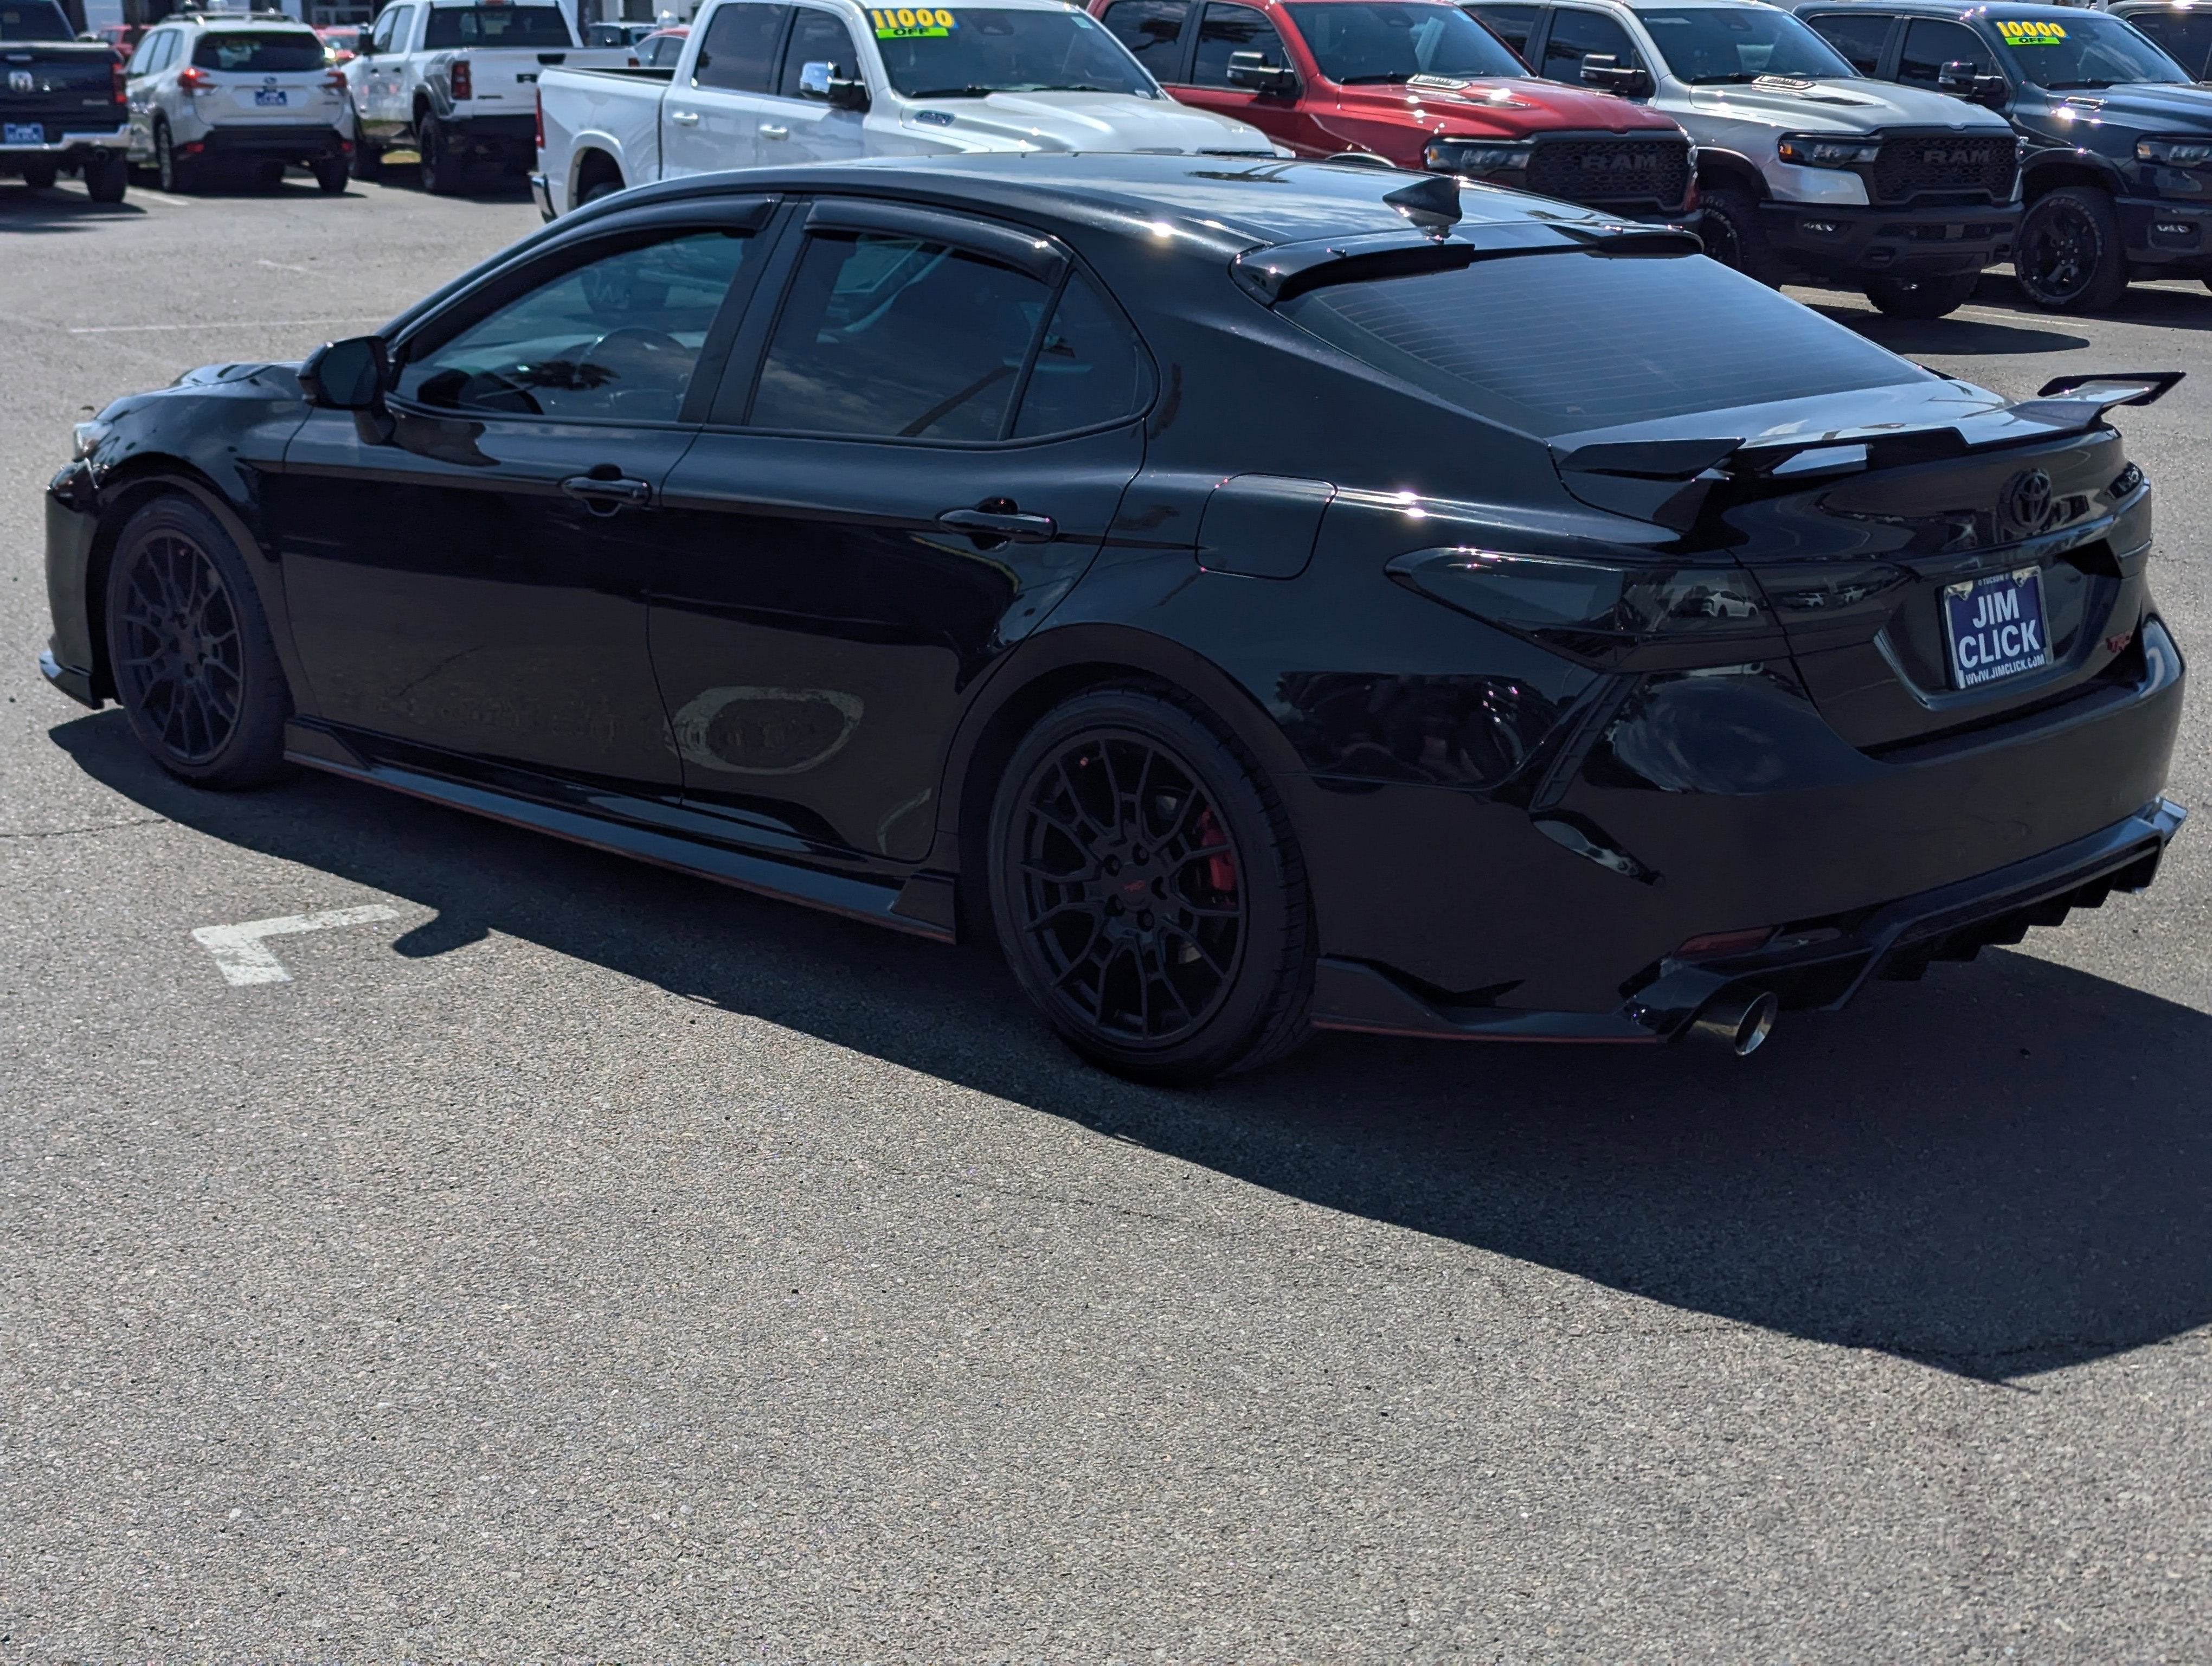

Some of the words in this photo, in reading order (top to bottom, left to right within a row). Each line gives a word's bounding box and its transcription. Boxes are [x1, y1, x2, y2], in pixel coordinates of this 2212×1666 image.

[871, 9, 955, 29] 11000
[1996, 21, 2066, 37] 10000
[1580, 153, 1657, 170] RAM
[1924, 150, 1990, 163] RAM
[1972, 588, 2020, 629] JIM
[1959, 619, 2040, 668] CLICK
[1965, 653, 2045, 685] WWW.JIMCLICK.COM
